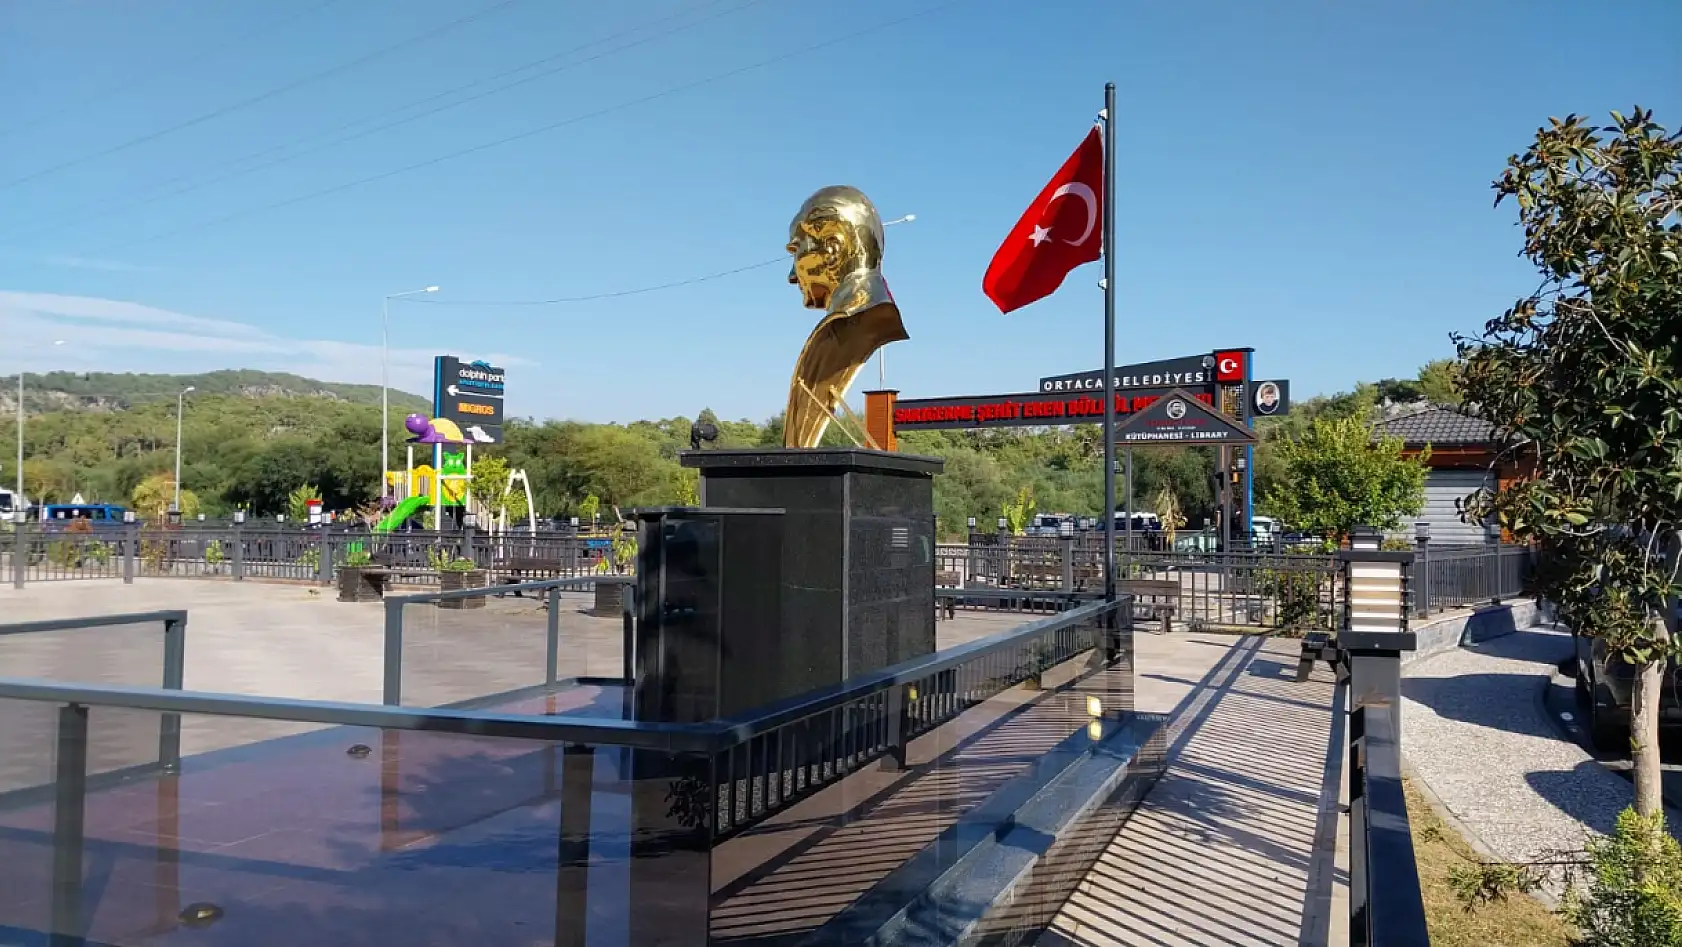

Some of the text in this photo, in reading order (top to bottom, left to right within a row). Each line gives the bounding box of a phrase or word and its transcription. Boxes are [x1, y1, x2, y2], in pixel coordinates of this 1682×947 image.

[459, 368, 487, 381] dolphin
[1043, 378, 1103, 391] ORTACA
[458, 402, 494, 414] MIGROS
[1125, 430, 1183, 440] KÜTÜPHANESİ
[1191, 431, 1229, 439] LIBRARY
